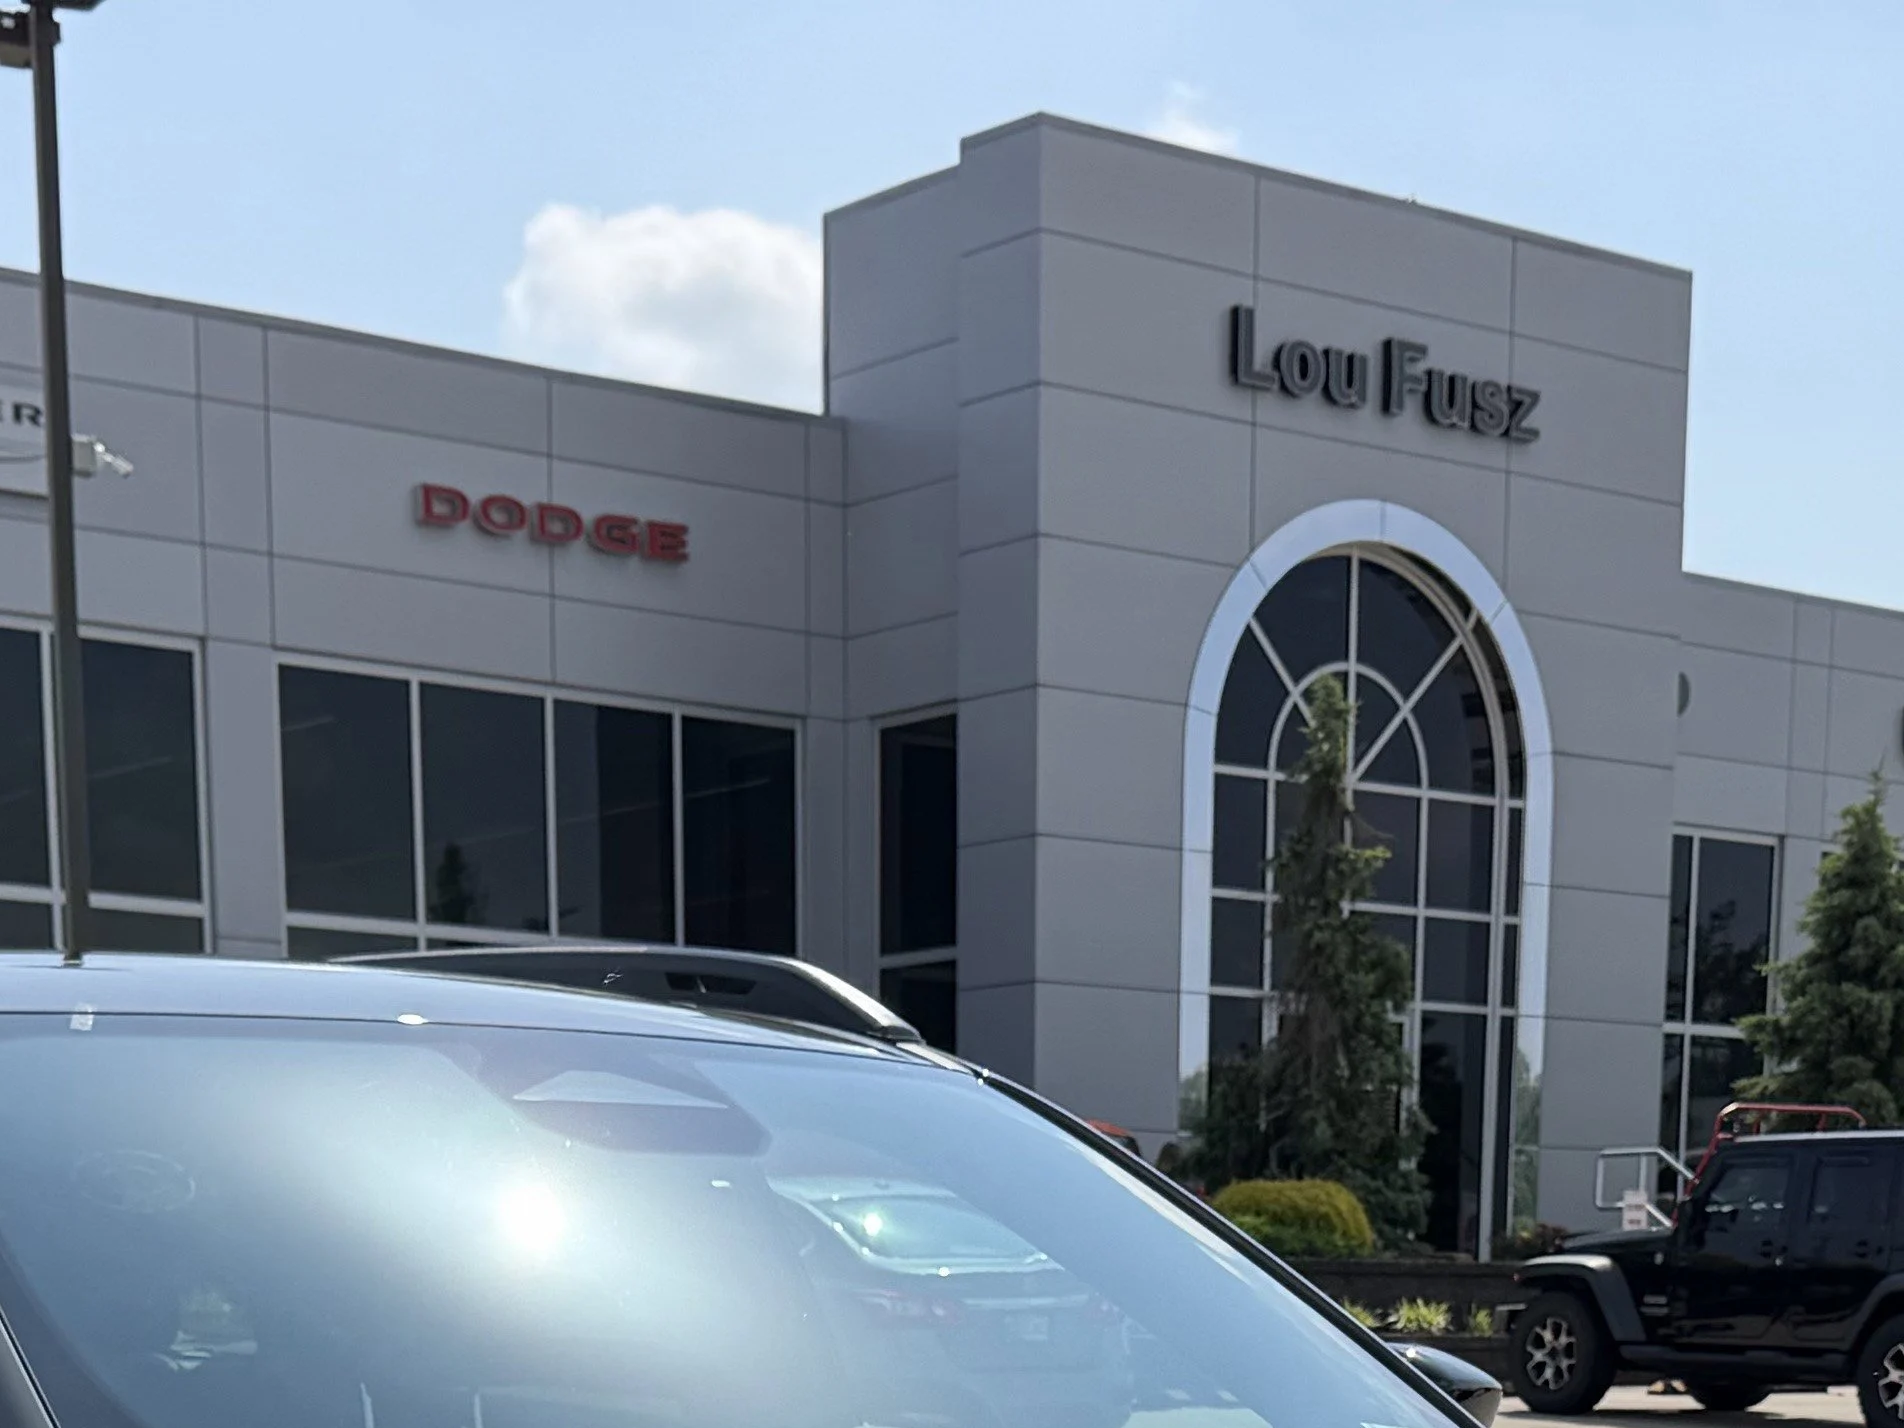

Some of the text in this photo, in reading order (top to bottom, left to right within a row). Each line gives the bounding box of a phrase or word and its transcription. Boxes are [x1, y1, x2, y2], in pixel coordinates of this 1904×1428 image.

[1229, 304, 1542, 445] Lou Fusz
[414, 482, 690, 564] DODGE
